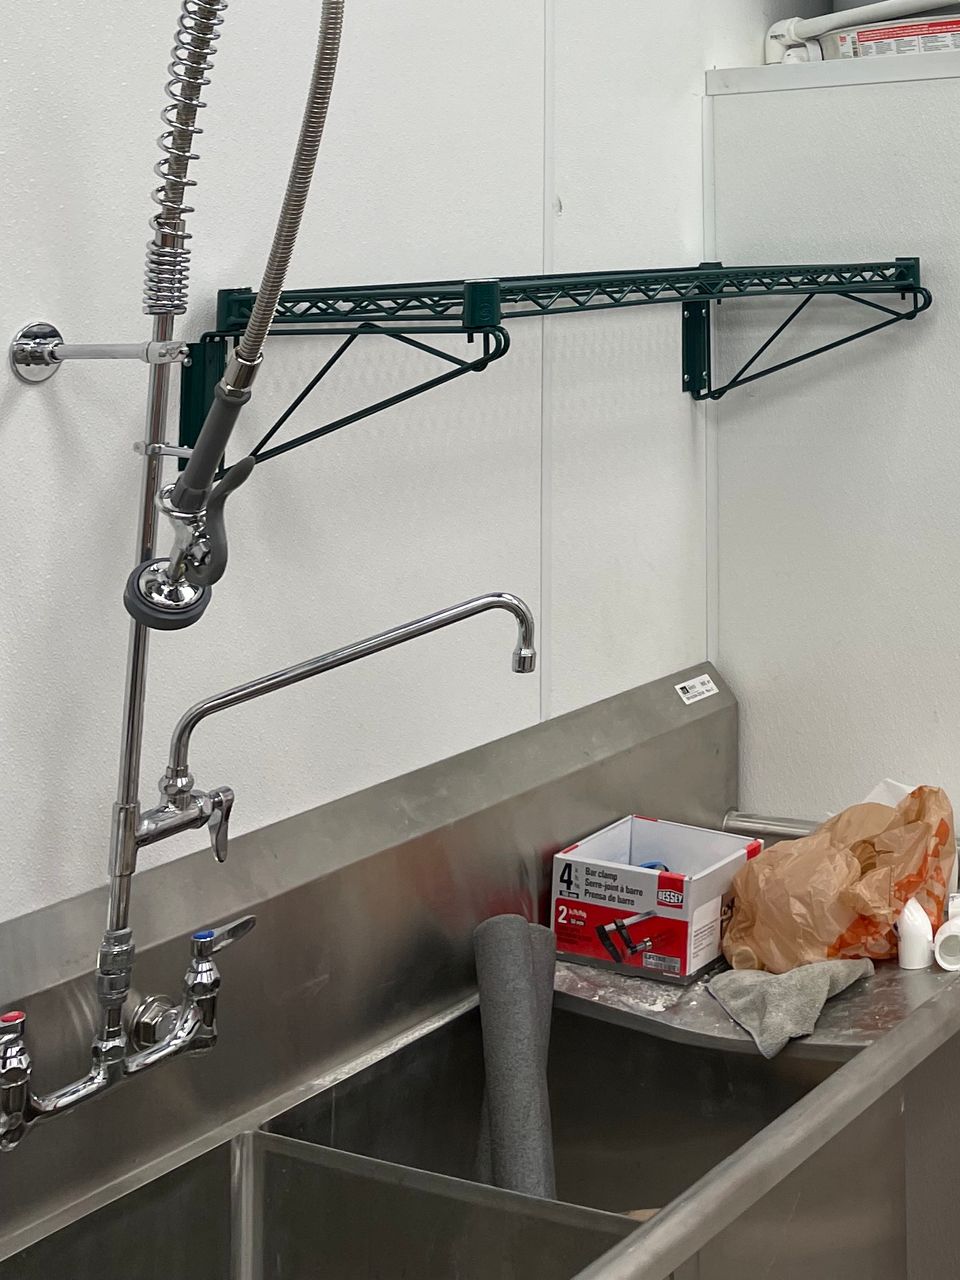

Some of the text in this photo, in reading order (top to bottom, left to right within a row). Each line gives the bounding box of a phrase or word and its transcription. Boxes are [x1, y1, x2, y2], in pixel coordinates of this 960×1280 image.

[559, 862, 573, 891] 4
[585, 867, 618, 882] Bar clamp
[584, 878, 619, 892] Serre-joint
[608, 894, 617, 903] de
[658, 891, 683, 904] BESSEY
[557, 905, 568, 924] 2
